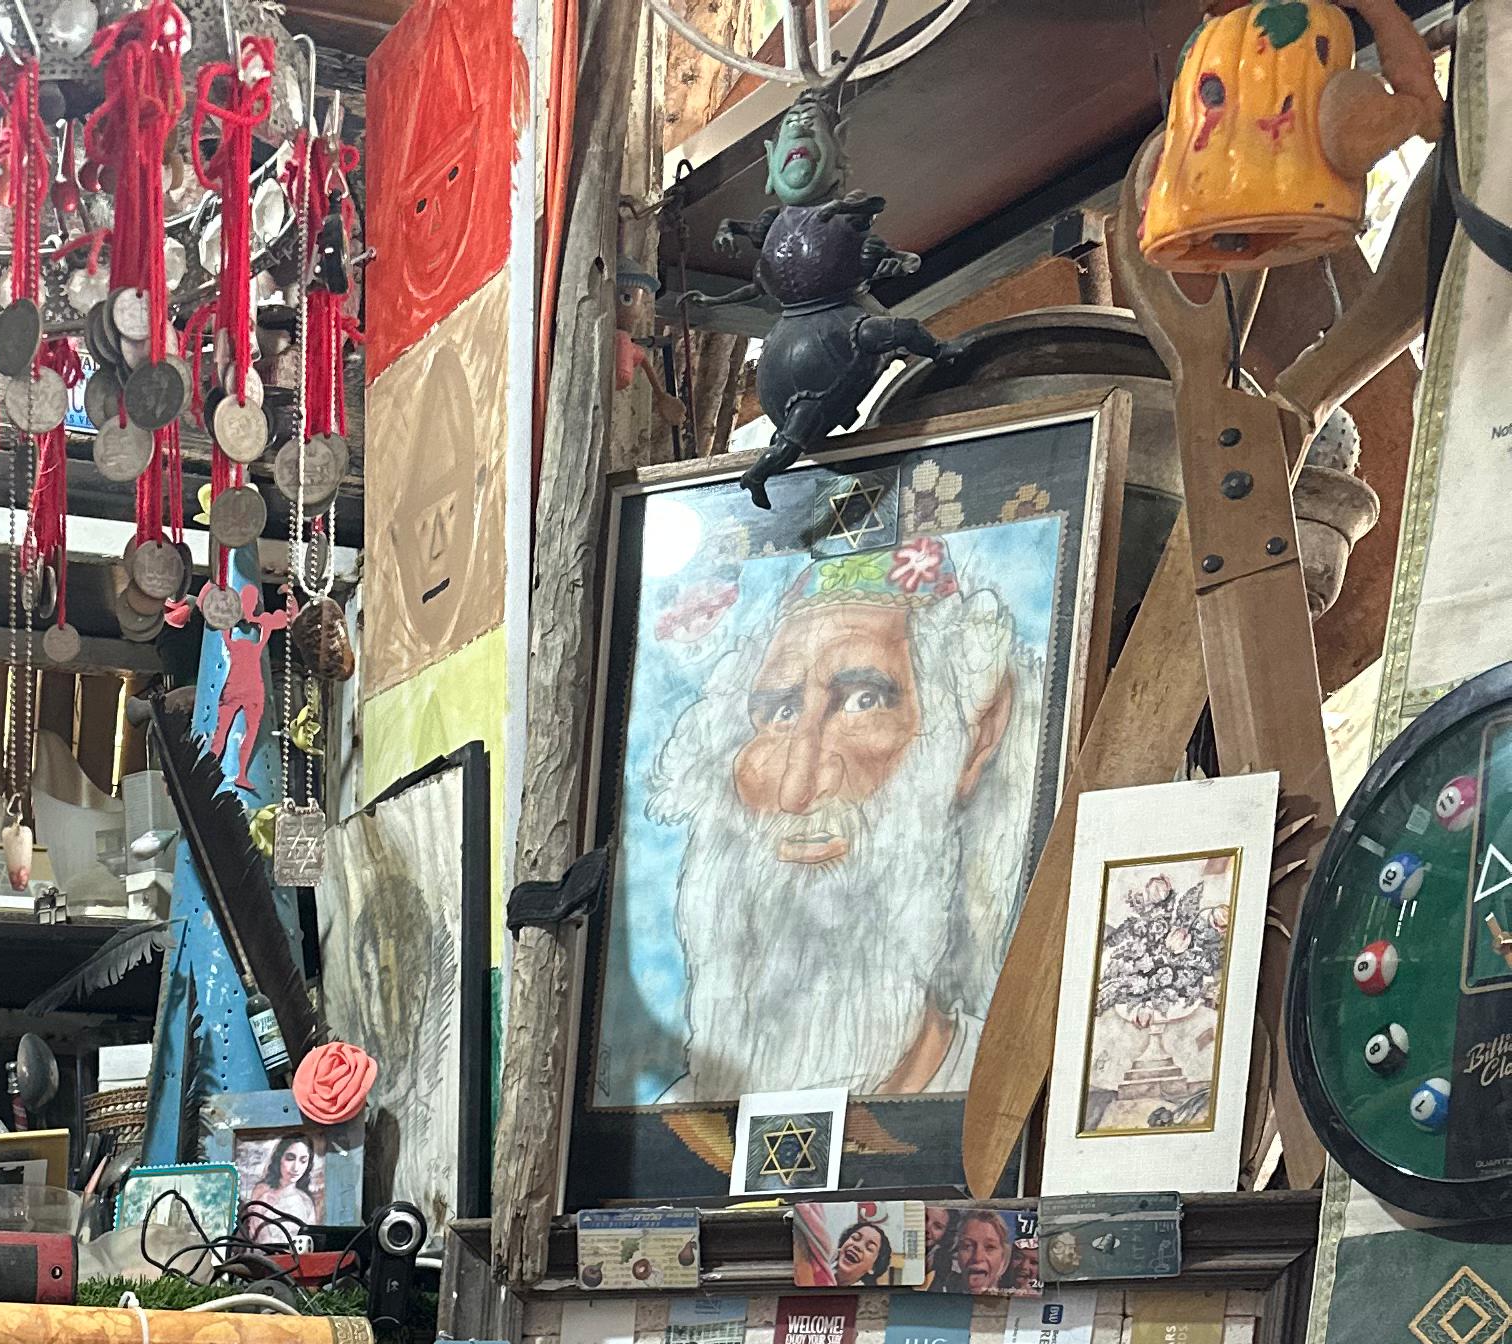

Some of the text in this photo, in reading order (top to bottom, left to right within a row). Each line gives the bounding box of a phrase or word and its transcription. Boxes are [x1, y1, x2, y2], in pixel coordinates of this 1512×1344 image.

[1382, 869, 1397, 886] 10
[788, 1315, 845, 1335] WELCOME!
[785, 1334, 806, 1344] ENJOY
[808, 1335, 826, 1344] YOUR
